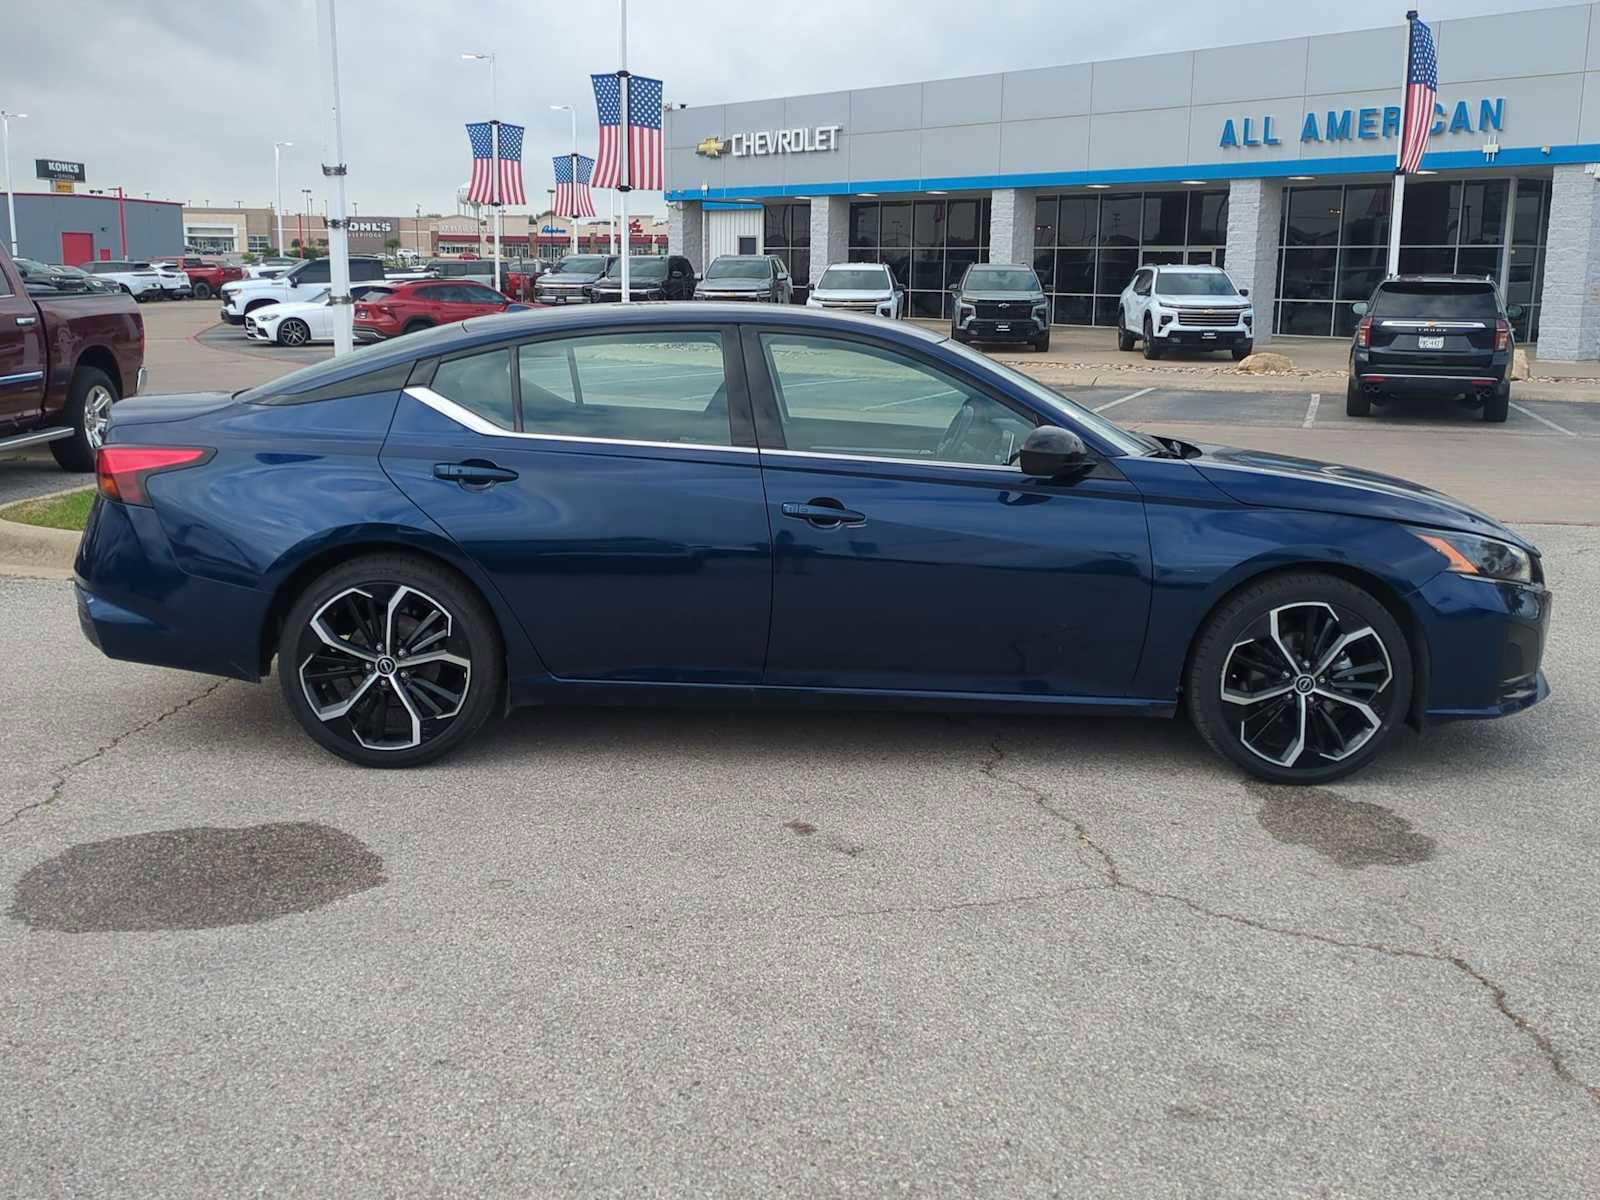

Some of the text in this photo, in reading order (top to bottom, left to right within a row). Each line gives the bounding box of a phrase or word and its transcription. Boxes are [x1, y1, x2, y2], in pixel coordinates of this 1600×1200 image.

[1219, 97, 1506, 148] ALL AMERCAN
[731, 126, 840, 156] CHEVROLET
[48, 161, 79, 174] KOHL'S
[349, 222, 391, 232] OHL'S
